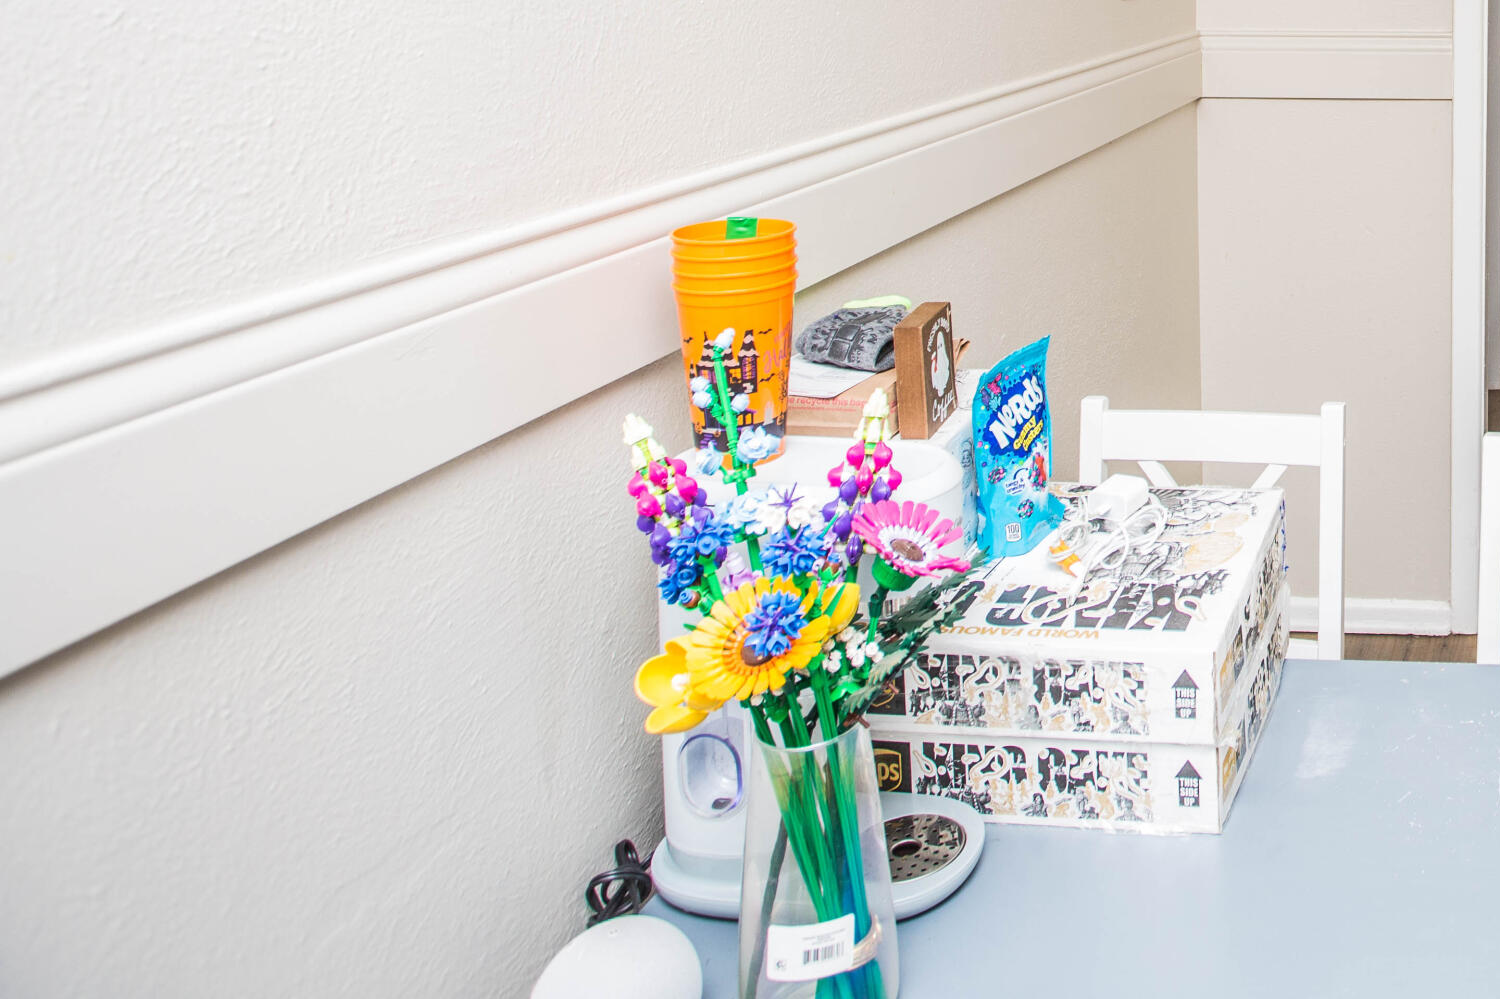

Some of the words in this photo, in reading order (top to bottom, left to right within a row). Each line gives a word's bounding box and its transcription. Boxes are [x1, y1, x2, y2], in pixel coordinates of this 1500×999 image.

[1027, 628, 1100, 640] WORLD
[1175, 687, 1196, 698] THIS
[1175, 698, 1196, 709] SIDE
[1180, 709, 1193, 718] UP
[876, 762, 900, 788] ps
[1178, 778, 1199, 788] THIS
[1179, 788, 1199, 797] SIDE
[1183, 797, 1195, 807] UP
